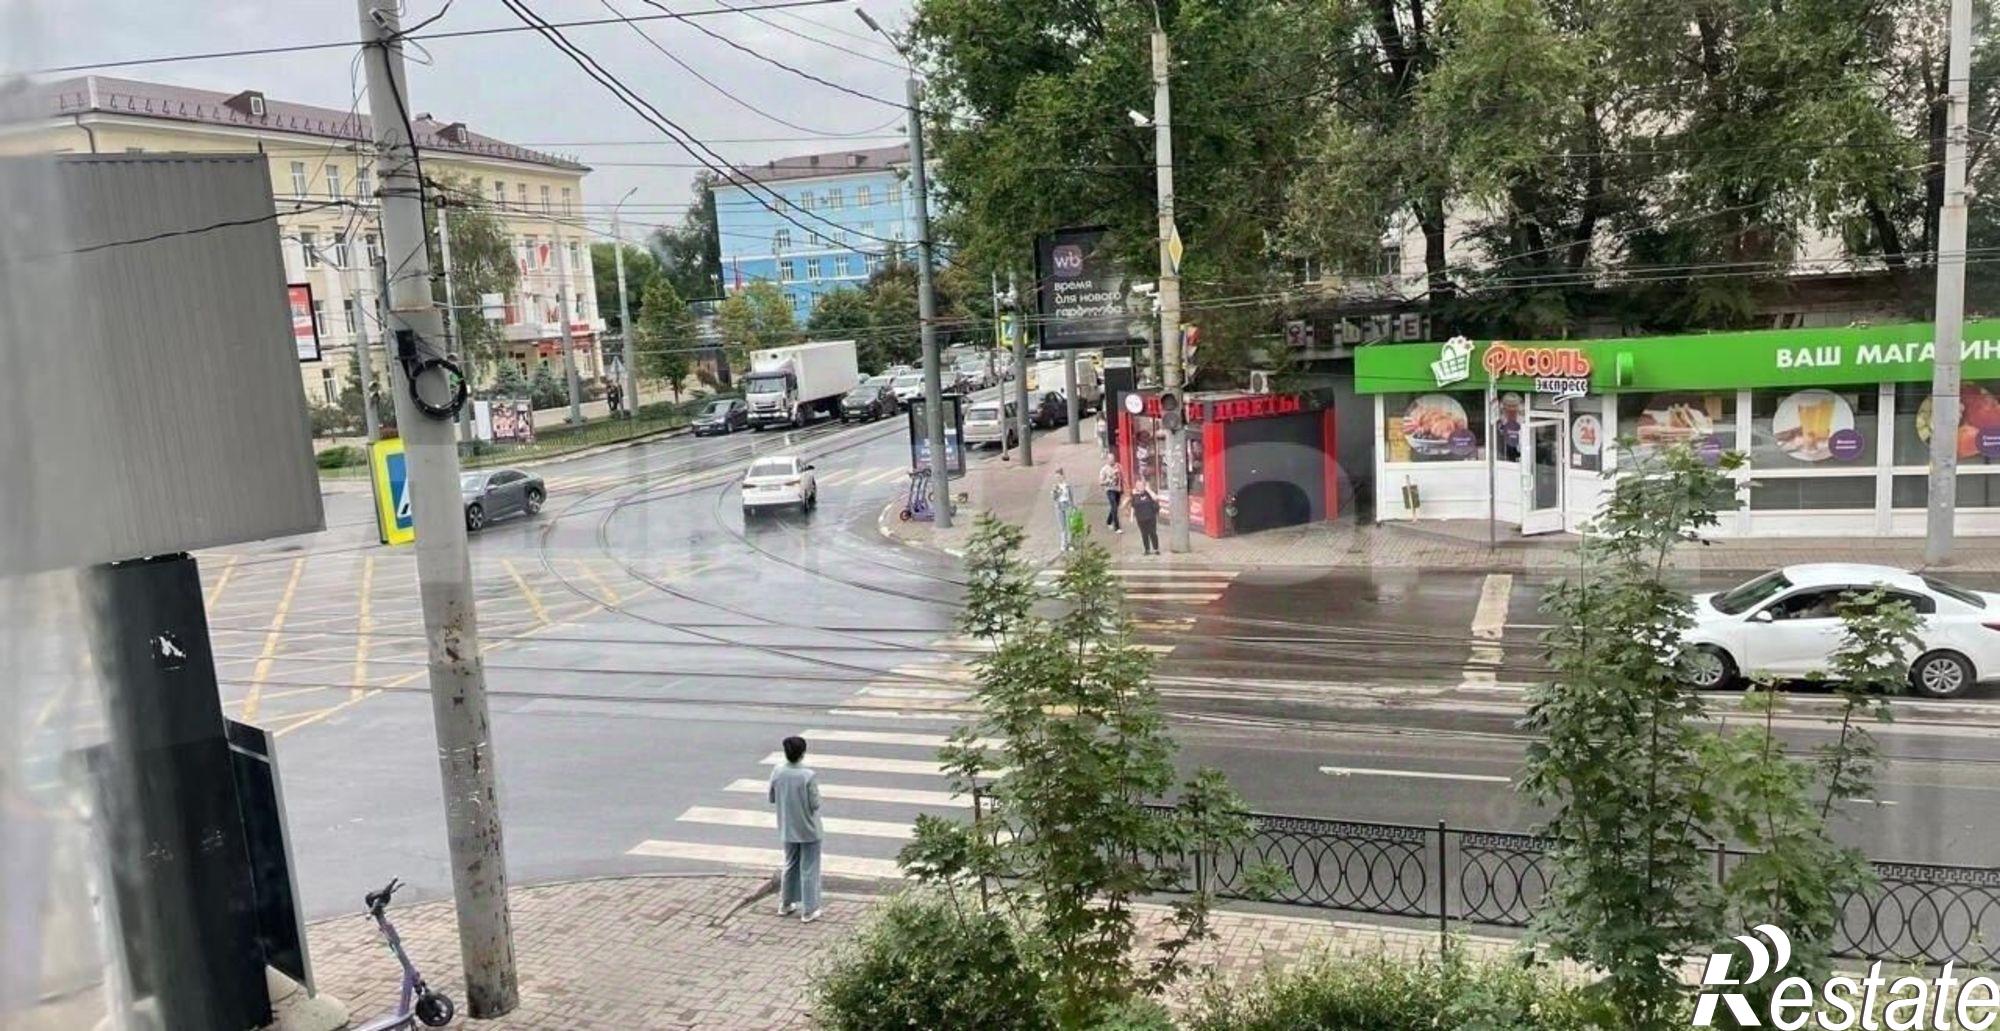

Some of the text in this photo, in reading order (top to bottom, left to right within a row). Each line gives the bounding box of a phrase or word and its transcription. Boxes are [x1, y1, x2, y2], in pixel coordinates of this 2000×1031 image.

[1054, 251, 1080, 268] wb
[1054, 280, 1093, 293] время
[1055, 291, 1122, 305] для нового
[1484, 343, 1590, 378] ФАСОЛЬ
[1776, 339, 2000, 368] ВАШ МАГАИН
[1214, 394, 1300, 423] ЦВЕТЫ
